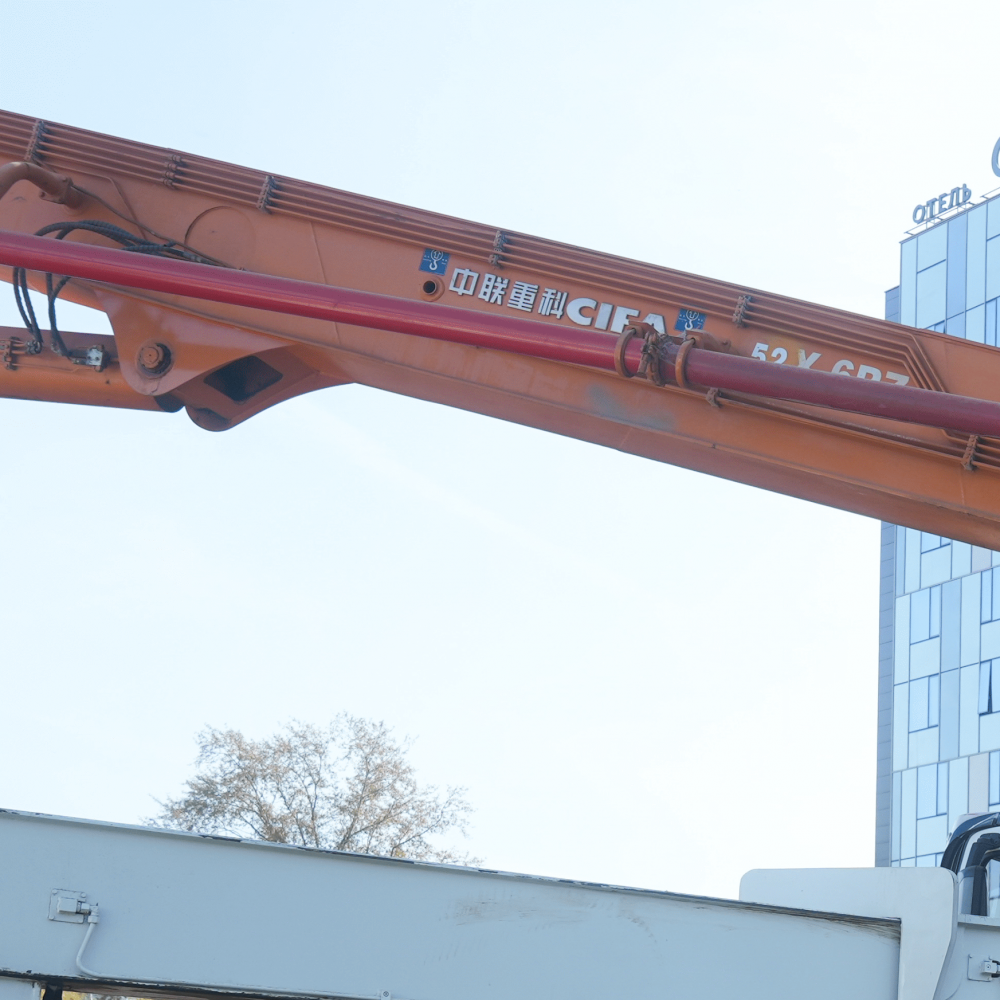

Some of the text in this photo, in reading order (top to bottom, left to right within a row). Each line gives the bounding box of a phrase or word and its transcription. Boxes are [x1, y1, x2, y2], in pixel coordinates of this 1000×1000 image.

[912, 183, 972, 224] ОТЕЛЬ
[448, 268, 568, 319] 中联重科
[566, 297, 667, 334] CIFA
